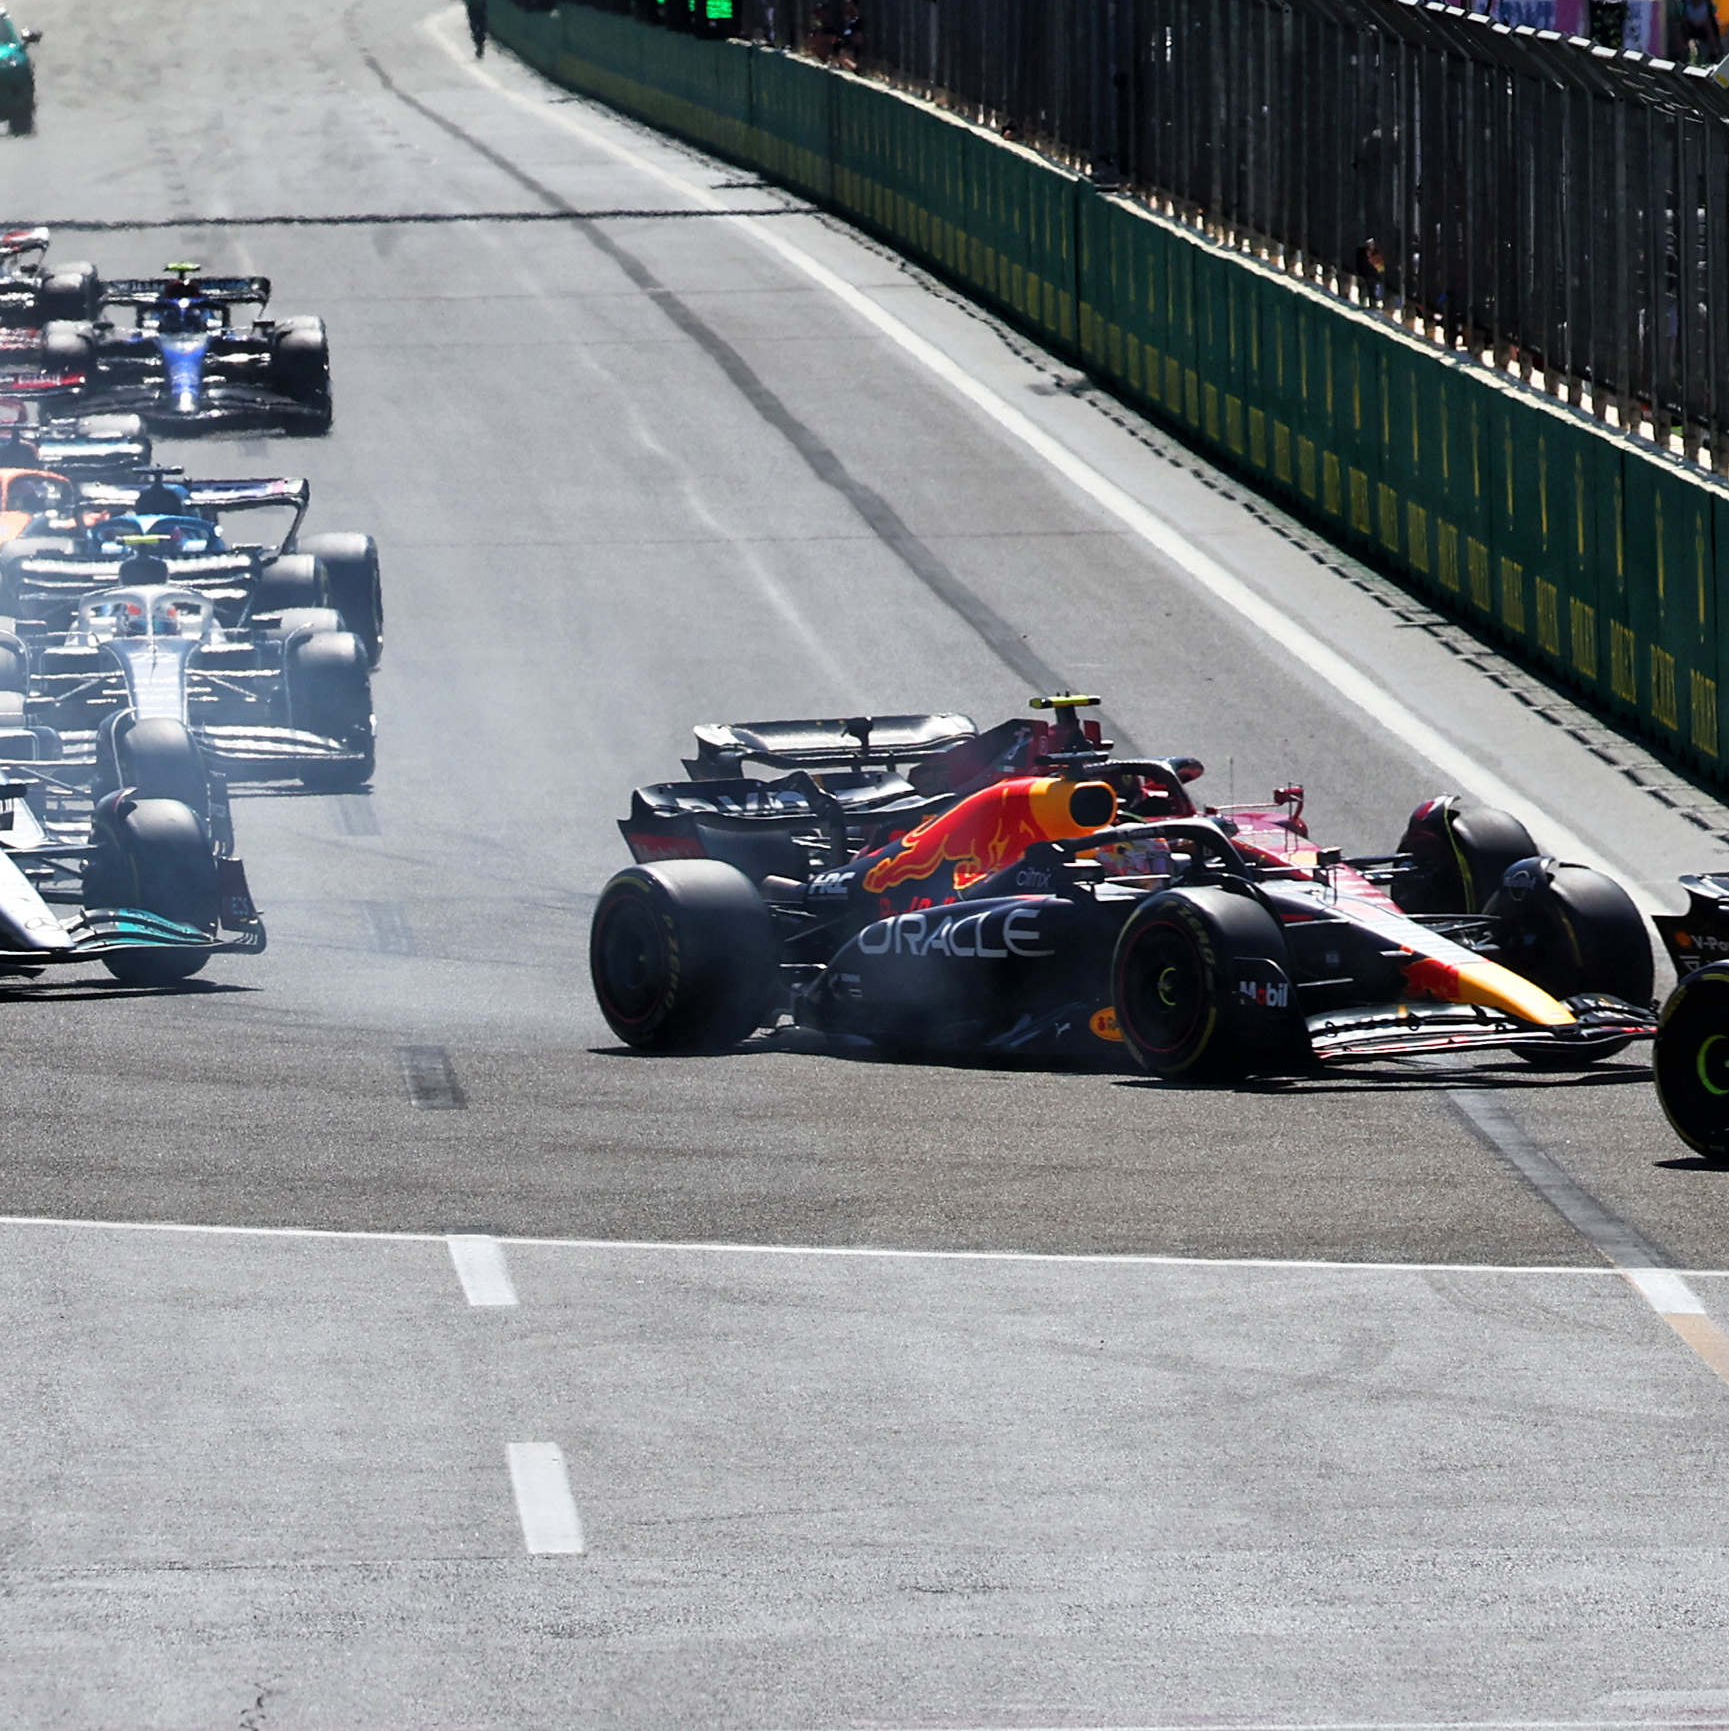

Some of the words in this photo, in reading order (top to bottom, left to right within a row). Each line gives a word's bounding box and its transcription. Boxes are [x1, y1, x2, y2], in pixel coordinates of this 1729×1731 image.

[808, 872, 857, 895] HRC
[1015, 867, 1053, 889] citrix
[858, 908, 1057, 958] ORACLE
[1239, 981, 1289, 1007] Mobil
